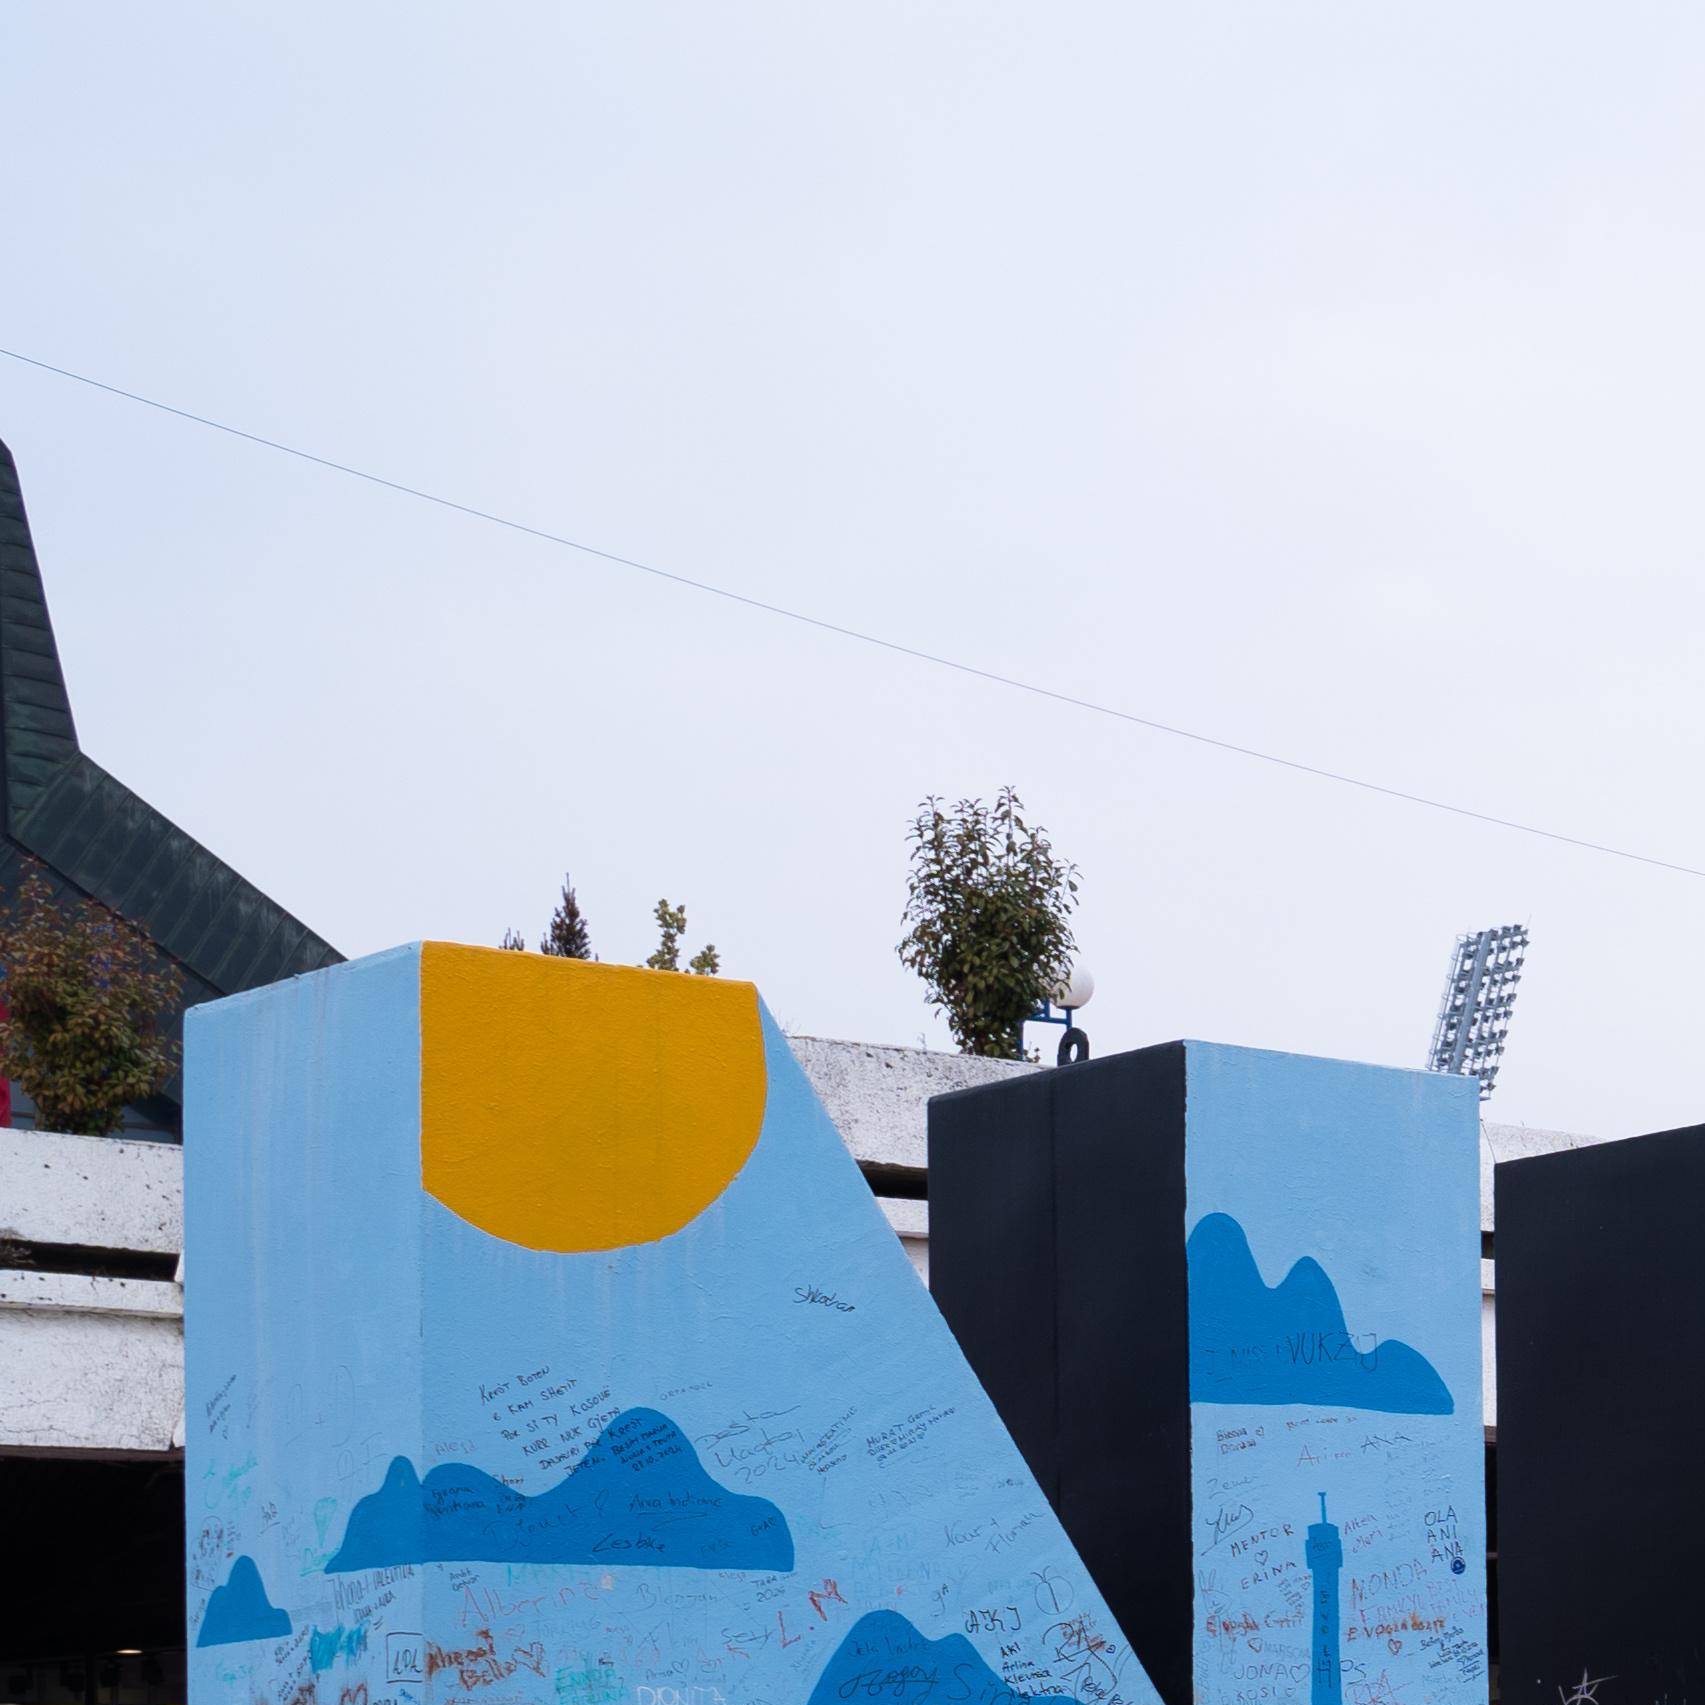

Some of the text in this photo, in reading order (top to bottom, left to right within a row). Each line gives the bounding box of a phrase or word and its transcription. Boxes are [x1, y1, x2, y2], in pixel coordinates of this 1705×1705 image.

[1424, 1504, 1459, 1527] OLA
[1231, 1523, 1295, 1558] MENTOR
[1427, 1525, 1458, 1543] ANI
[1431, 1541, 1465, 1564] ANA
[1241, 1560, 1297, 1590] ERINA
[1234, 1664, 1289, 1681] JONA
